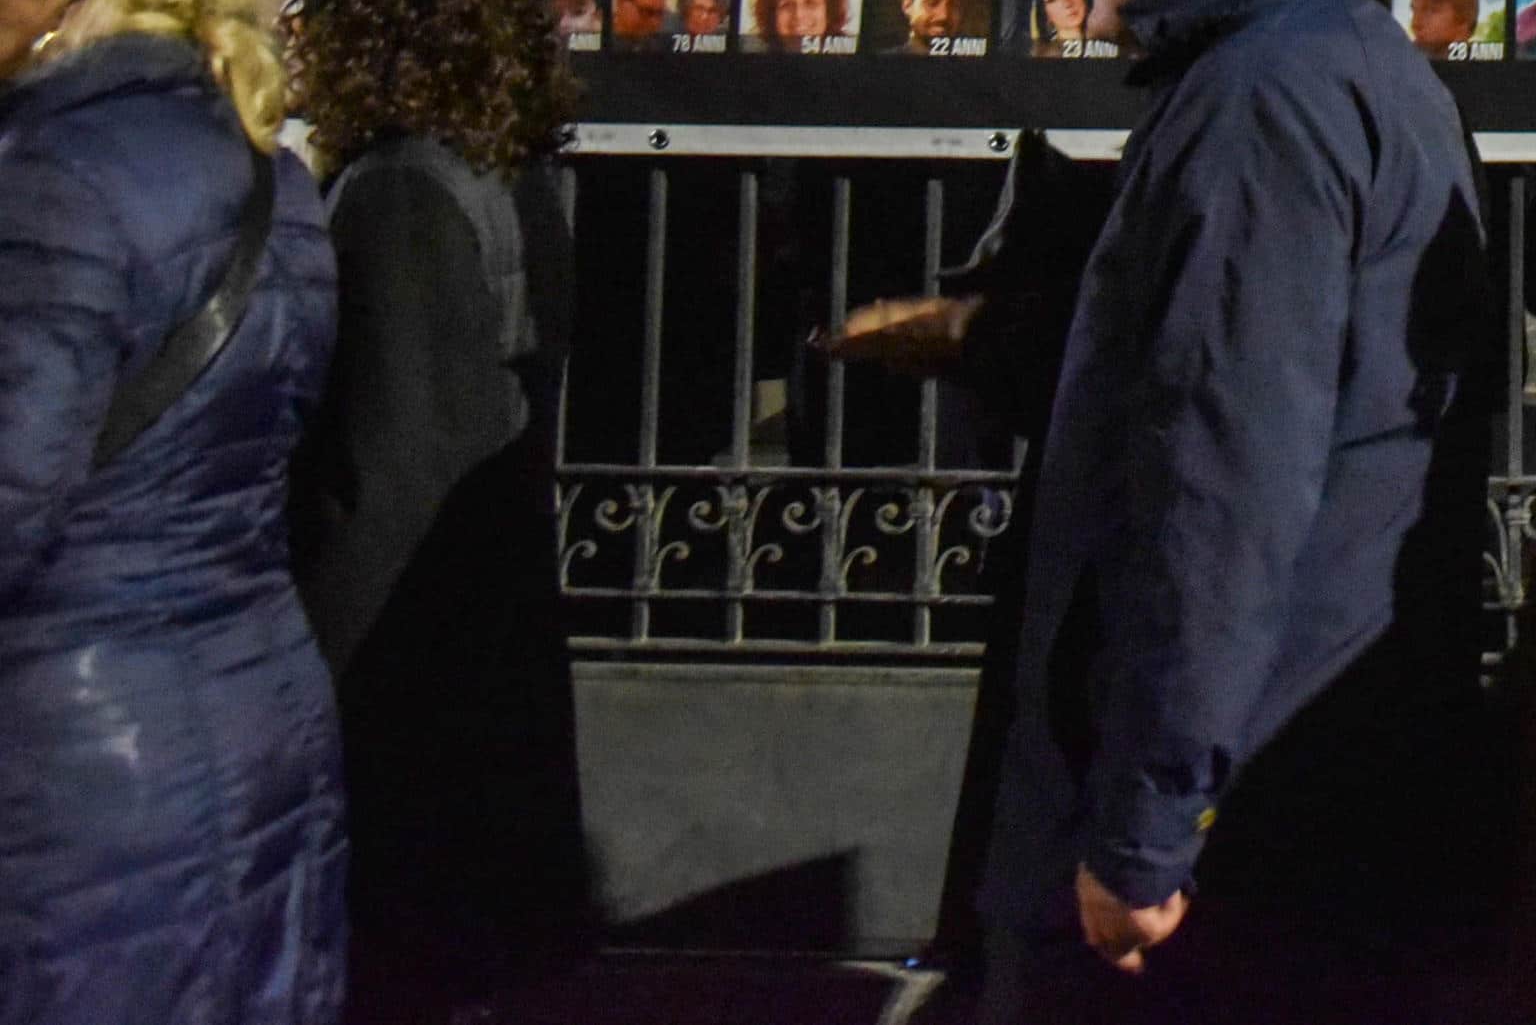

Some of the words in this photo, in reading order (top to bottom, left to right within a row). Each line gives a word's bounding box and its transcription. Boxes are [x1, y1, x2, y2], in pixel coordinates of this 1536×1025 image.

[691, 34, 726, 53] ANNI
[801, 36, 820, 54] 54
[822, 36, 857, 54] ANNI
[929, 37, 950, 56] 22
[951, 37, 987, 56] ANNI
[1062, 39, 1082, 58] 23
[1083, 39, 1118, 58] ANNI
[1469, 41, 1504, 61] ANNI
